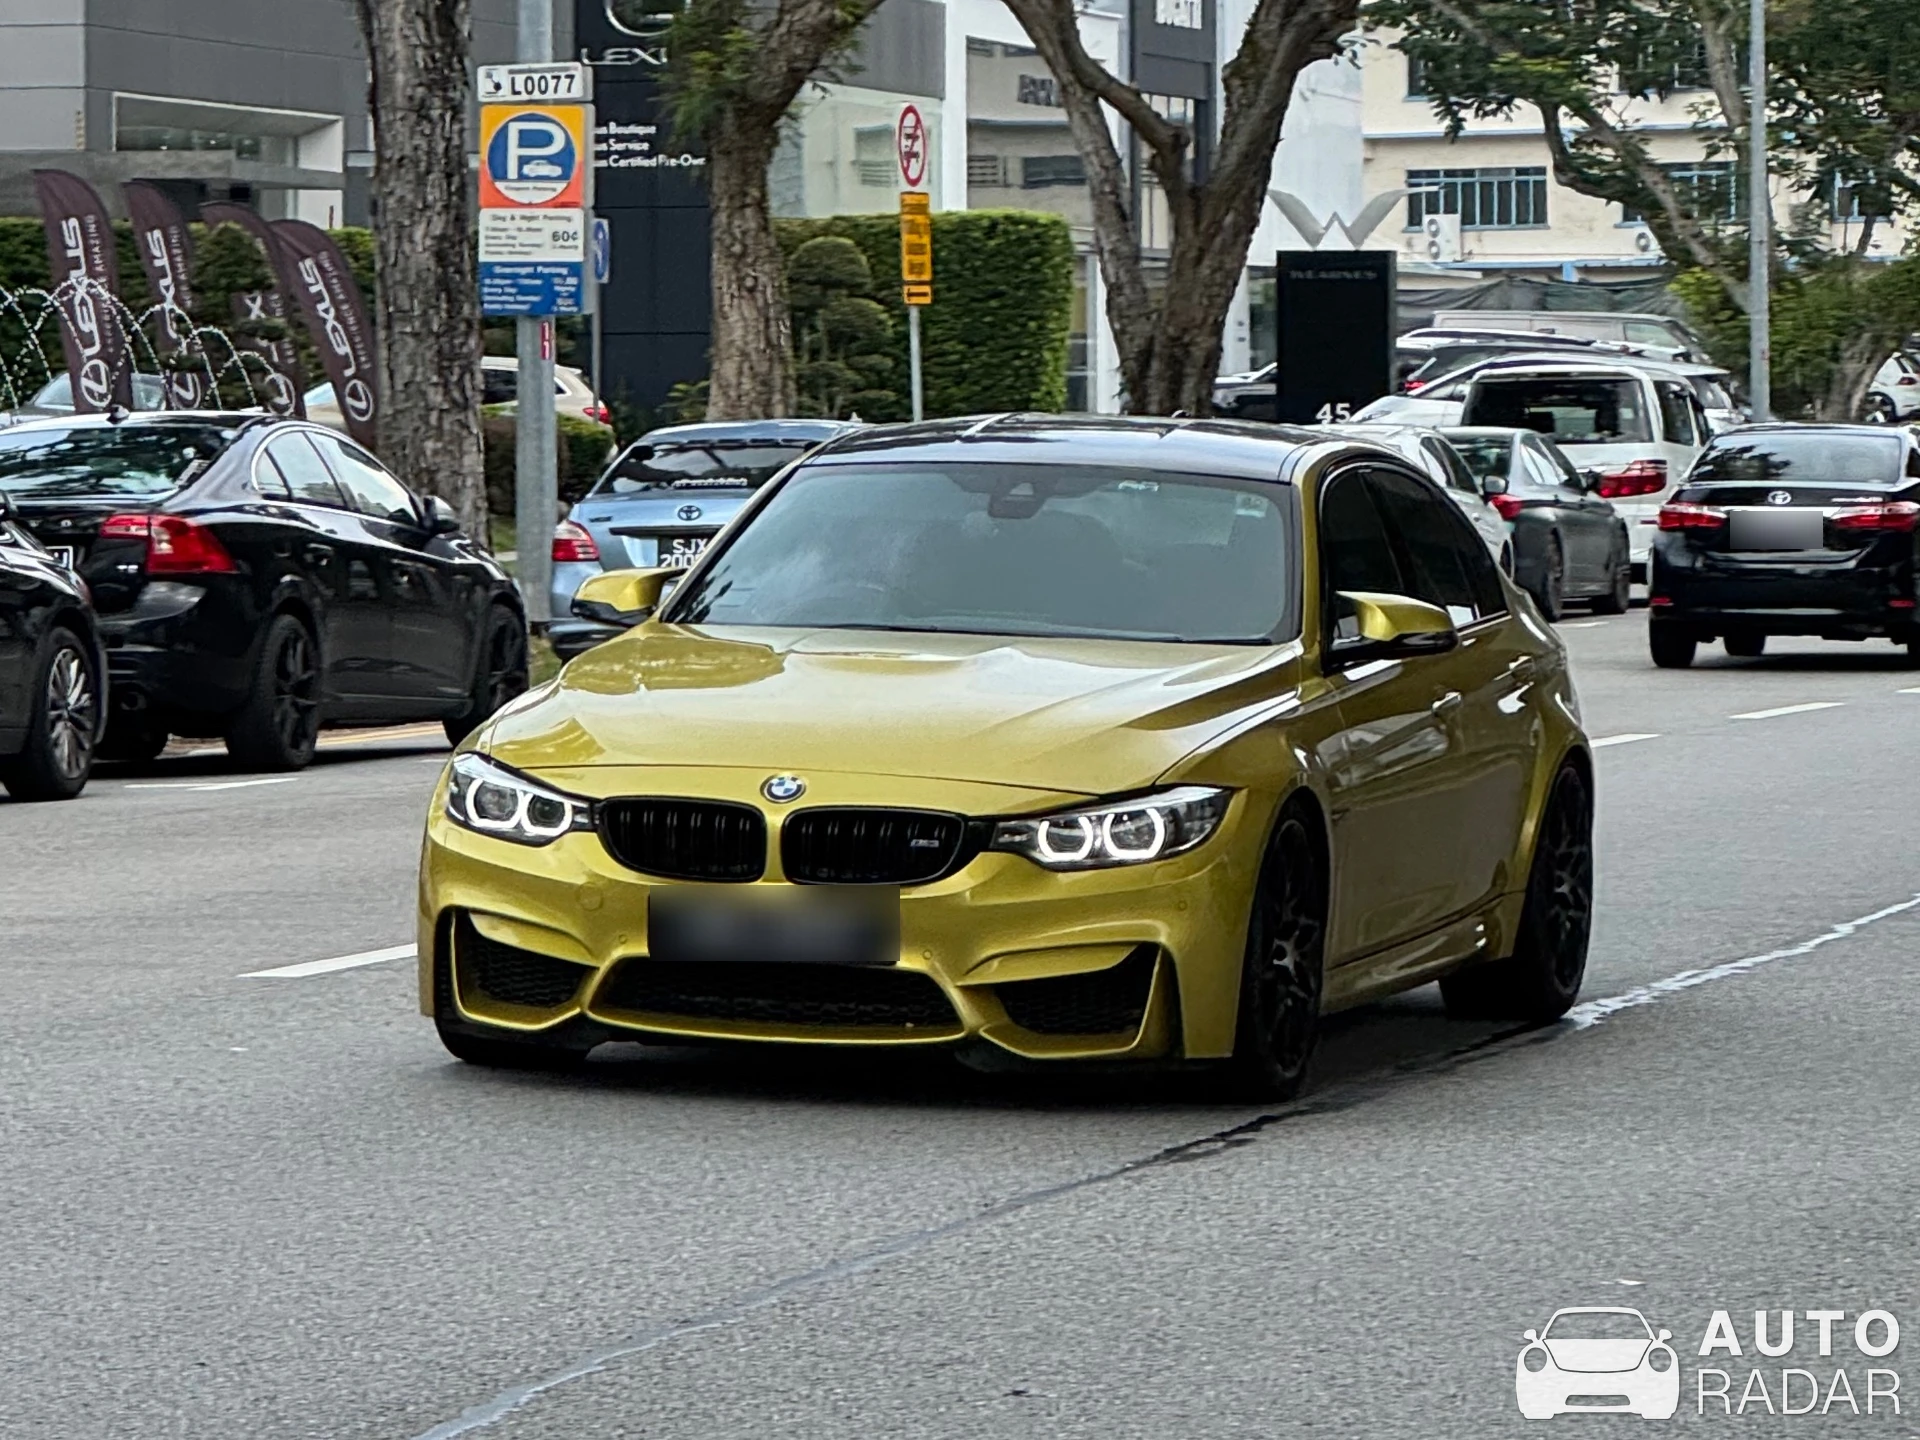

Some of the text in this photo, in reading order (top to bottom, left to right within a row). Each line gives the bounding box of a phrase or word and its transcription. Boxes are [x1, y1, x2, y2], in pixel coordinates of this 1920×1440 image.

[511, 74, 576, 95] L0077
[507, 121, 566, 180] P
[608, 138, 650, 151] Service
[608, 154, 657, 168] Certified
[61, 217, 101, 358] LEXUS
[298, 258, 356, 377] LEXUS
[1315, 402, 1352, 424] 45
[672, 538, 708, 554] SJX
[660, 553, 702, 569] 200
